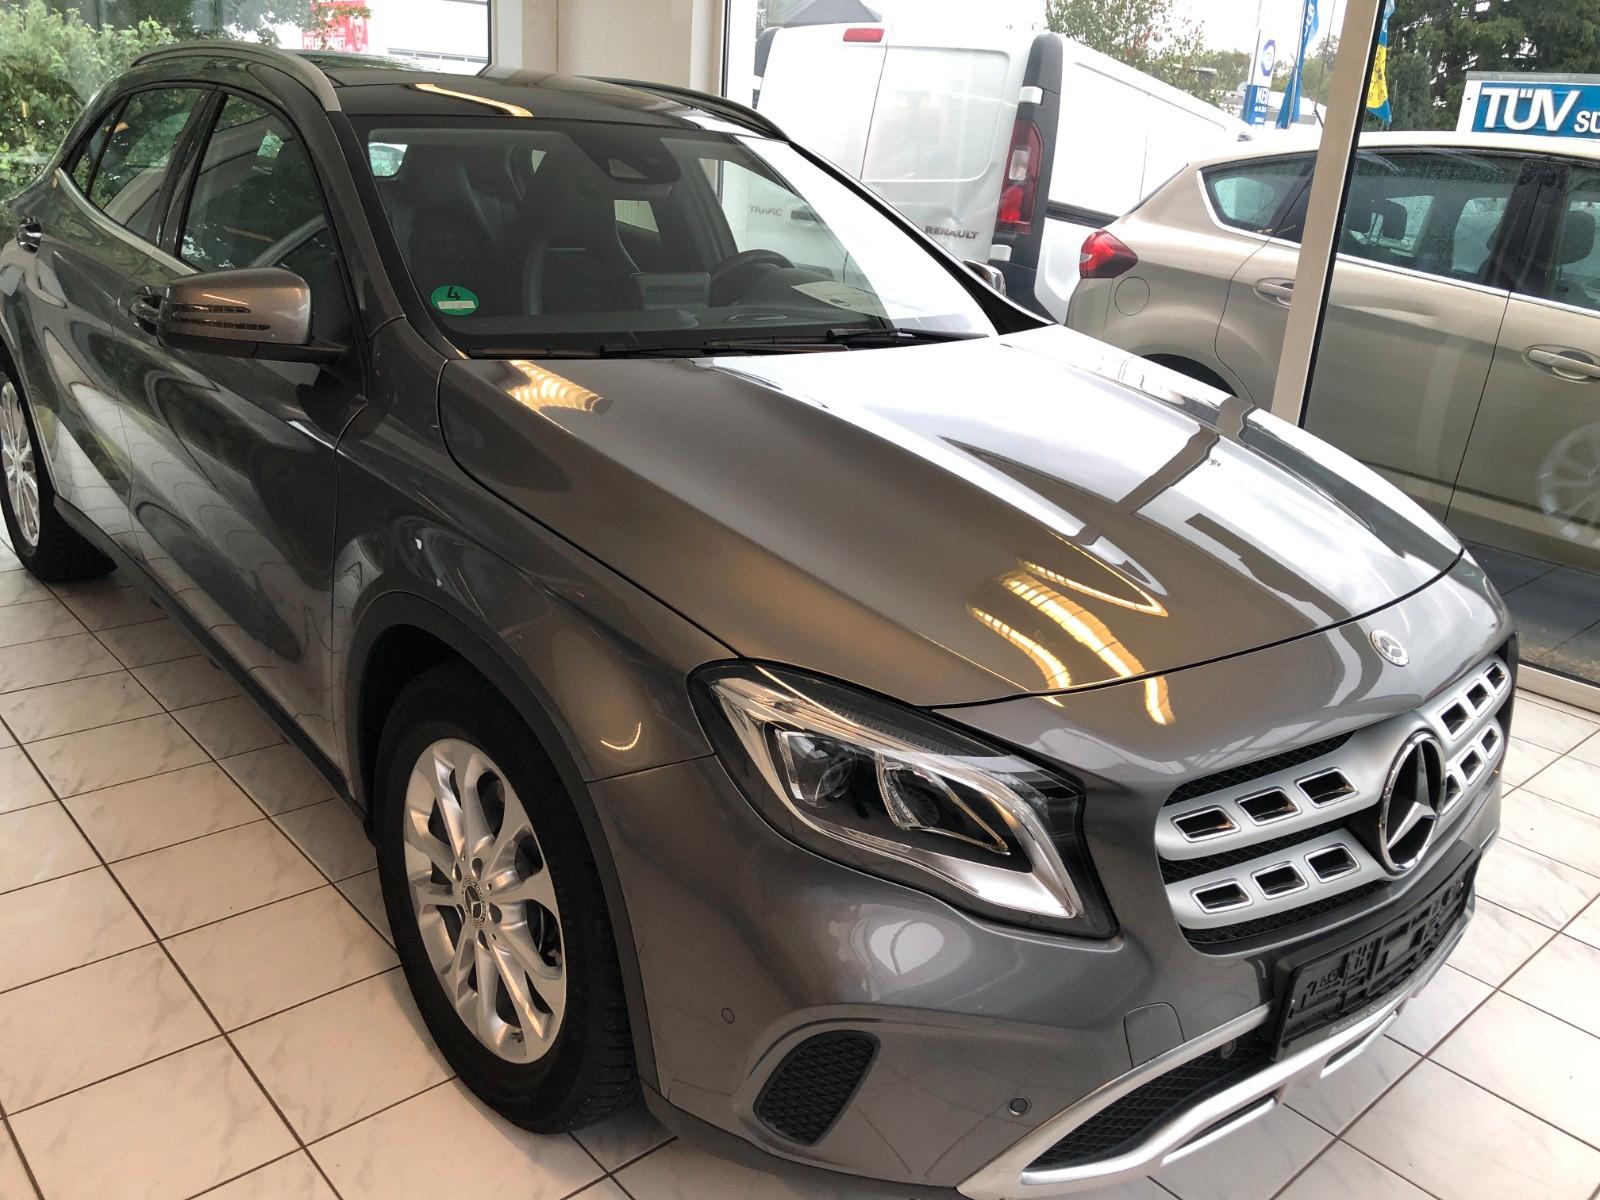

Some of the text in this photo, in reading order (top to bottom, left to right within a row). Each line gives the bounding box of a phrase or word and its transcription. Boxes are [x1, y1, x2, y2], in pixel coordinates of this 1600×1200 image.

[1480, 87, 1581, 131] TÜV
[924, 226, 979, 240] RENAULT
[447, 286, 461, 300] 4
